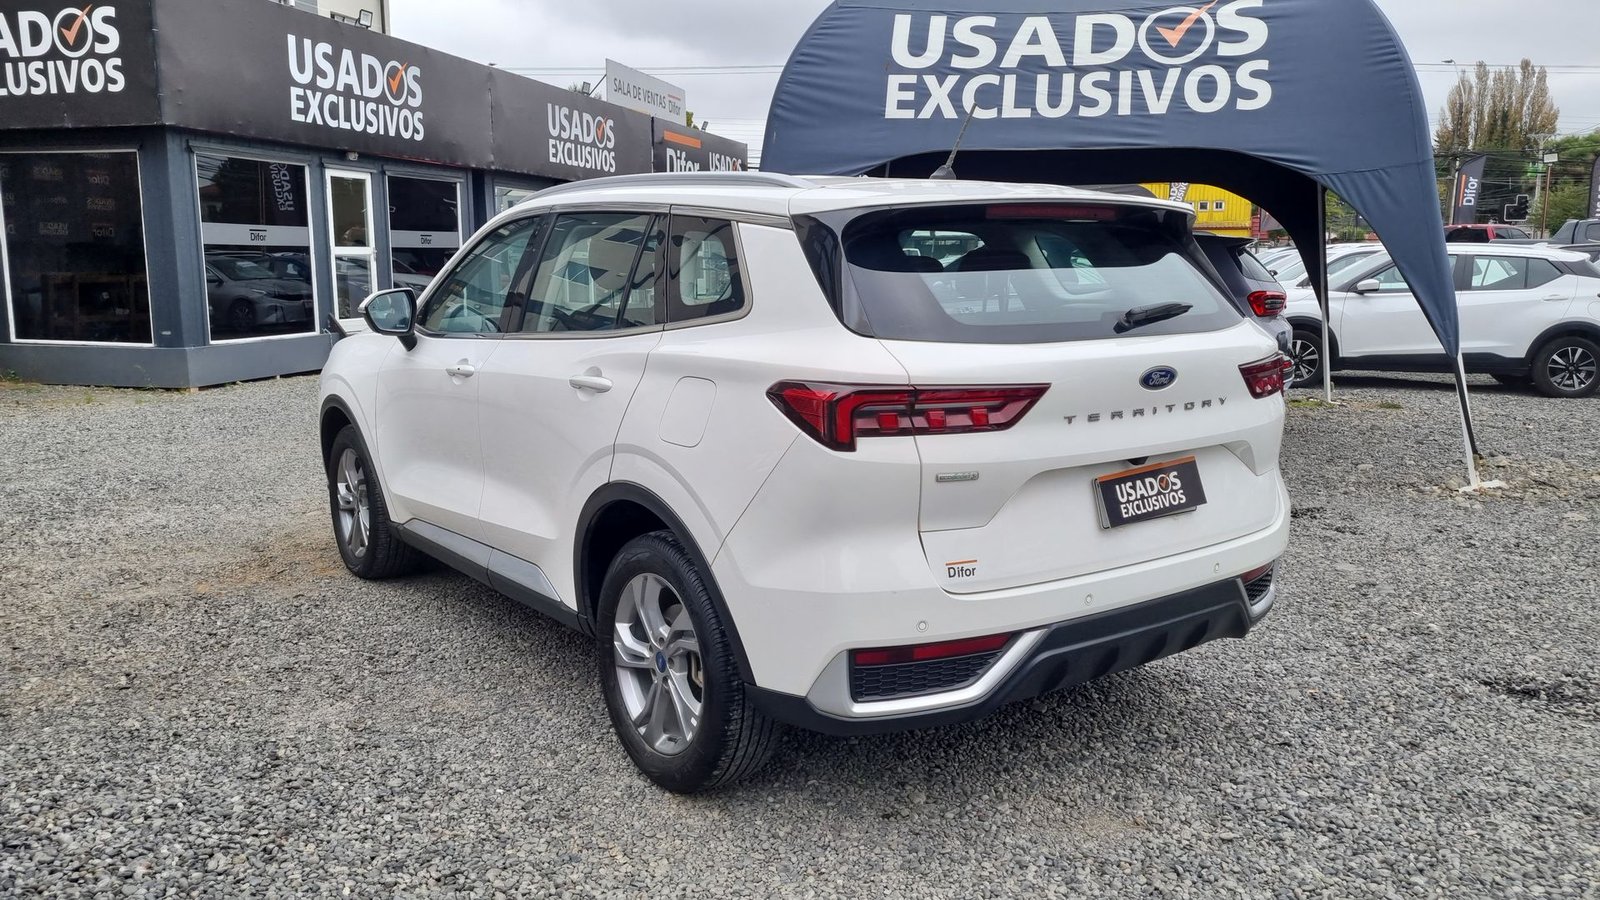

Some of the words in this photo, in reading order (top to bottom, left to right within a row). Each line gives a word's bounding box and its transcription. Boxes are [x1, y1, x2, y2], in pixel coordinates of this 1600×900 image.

[890, 0, 1269, 69] USADOS
[287, 34, 423, 108] USADOS
[613, 78, 631, 98] SALA
[632, 85, 642, 100] DE
[642, 88, 667, 109] VENTAS
[668, 100, 681, 116] Difor
[884, 59, 1273, 120] EXCLUSIVOS
[290, 86, 425, 142] EXCLUSIVOS
[547, 103, 615, 149] USADOS
[549, 138, 616, 173] EXCLUSIVOS
[1463, 176, 1479, 206] Difor
[250, 232, 267, 242] Difor
[1149, 371, 1171, 386] Ford
[1063, 397, 1227, 425] TERRITORY
[1115, 471, 1181, 503] USADOS
[1120, 490, 1187, 518] EXCLUSIVOS
[947, 566, 976, 578] Difor
